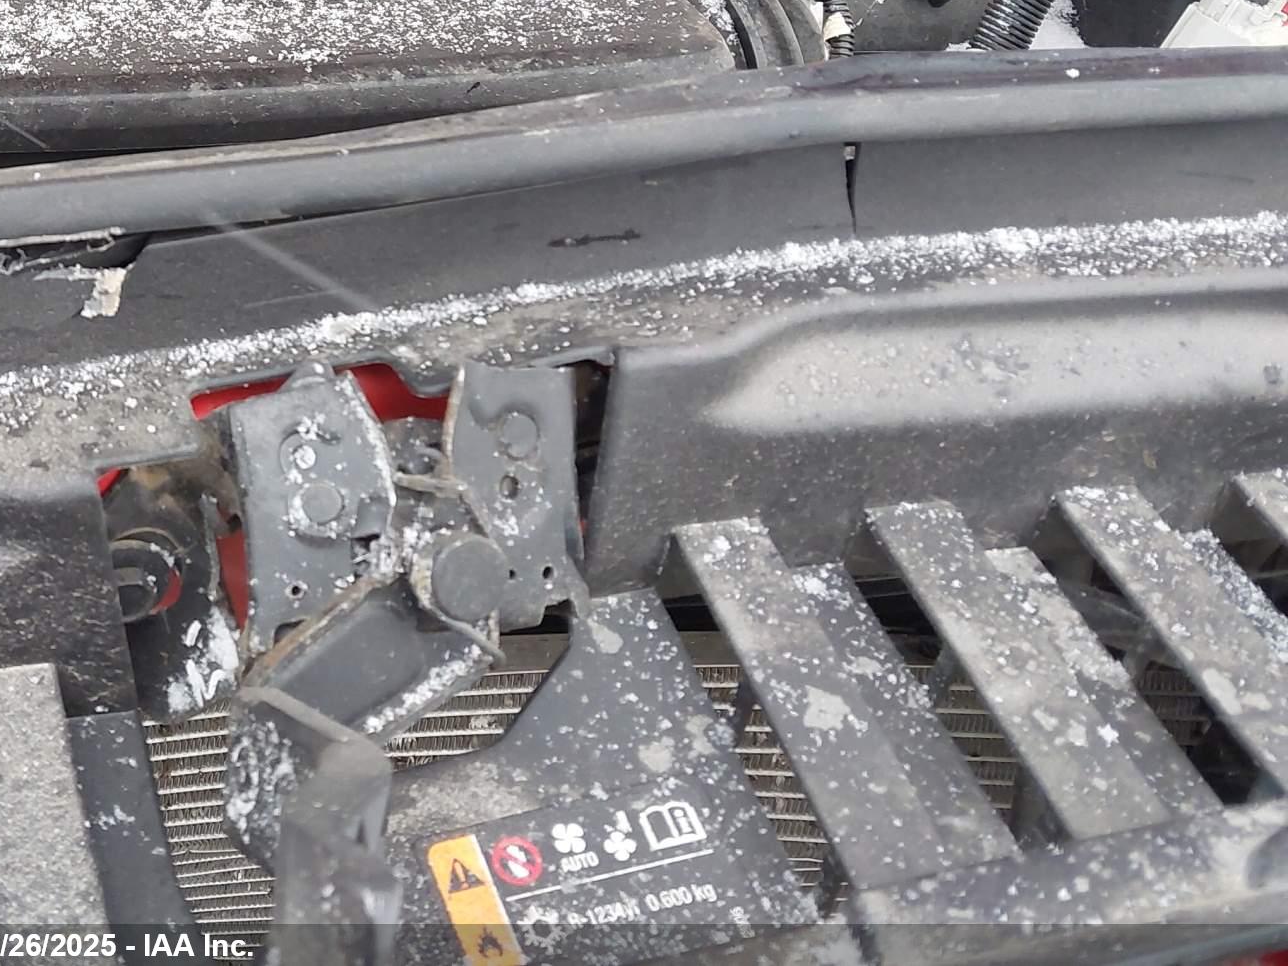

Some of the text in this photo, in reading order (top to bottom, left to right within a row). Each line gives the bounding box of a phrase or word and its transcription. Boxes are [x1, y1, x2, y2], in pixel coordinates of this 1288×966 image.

[560, 851, 599, 872] AUTO
[644, 887, 693, 912] 0.600
[691, 883, 718, 902] kg
